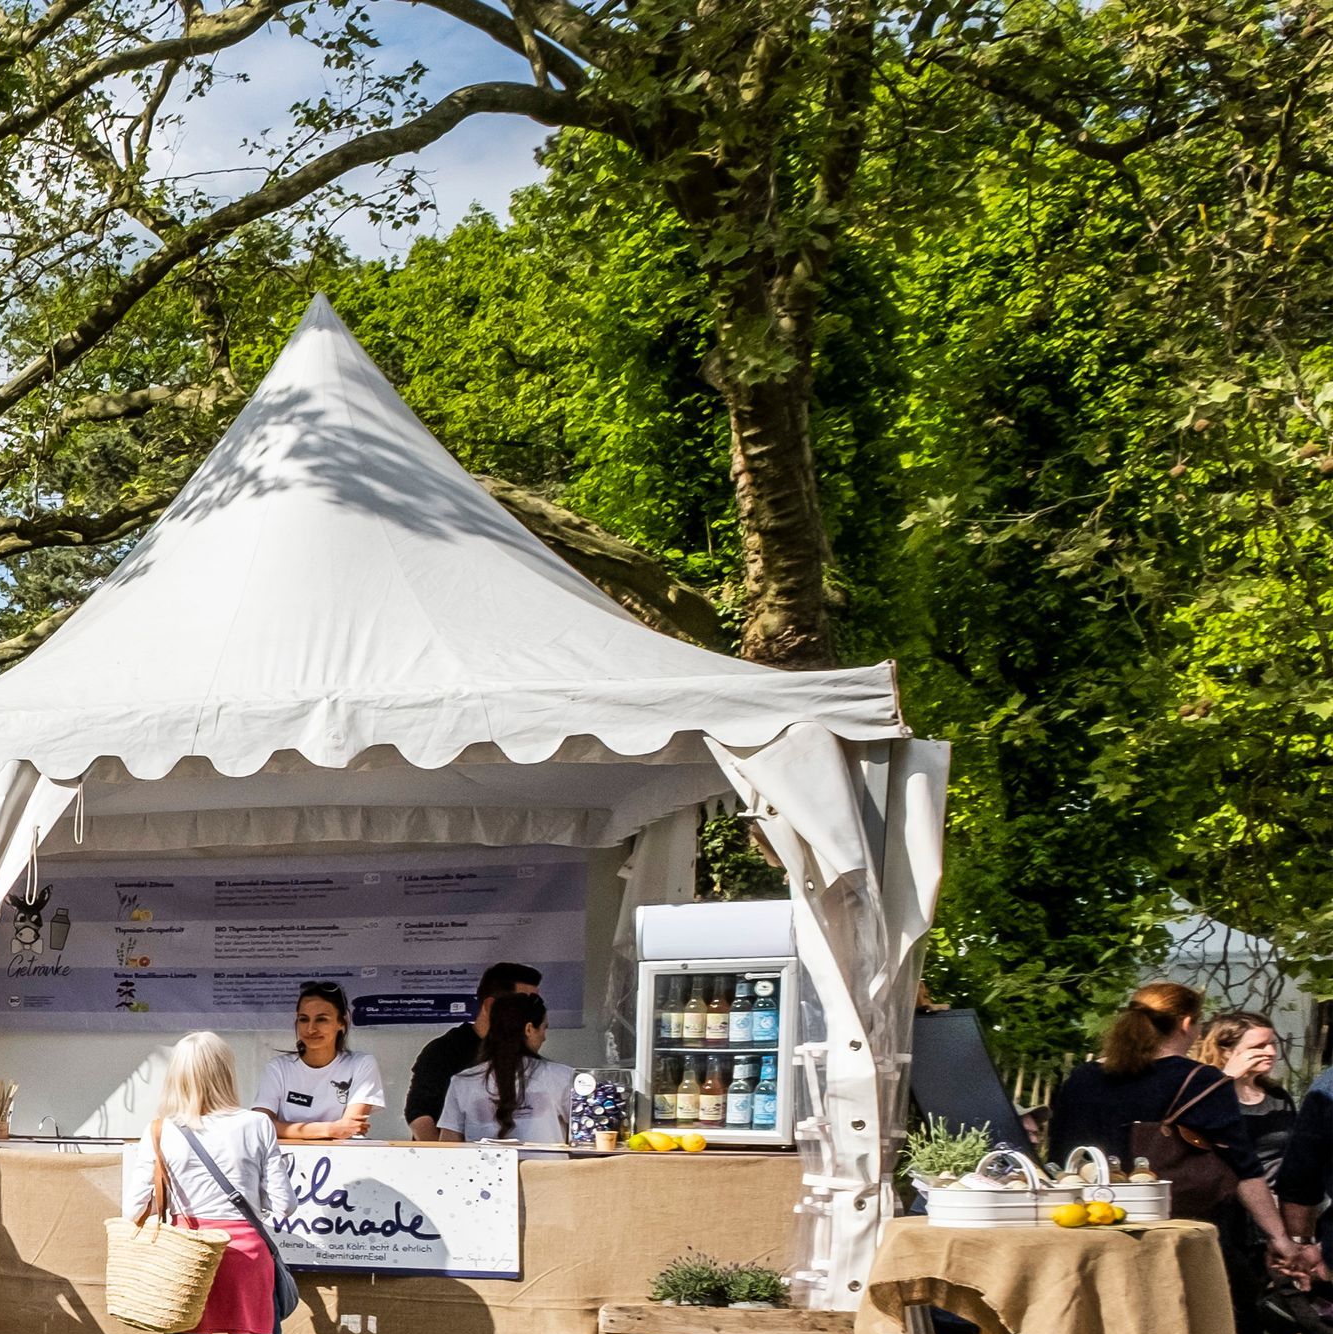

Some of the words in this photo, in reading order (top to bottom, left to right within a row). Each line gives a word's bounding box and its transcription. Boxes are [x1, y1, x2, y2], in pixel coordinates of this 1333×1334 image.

[7, 954, 71, 978] Getränke
[279, 1240, 304, 1249] deine
[306, 1241, 326, 1249] Lio
[369, 1243, 390, 1251] echt
[392, 1244, 399, 1252] &
[402, 1243, 432, 1253] ehrlich
